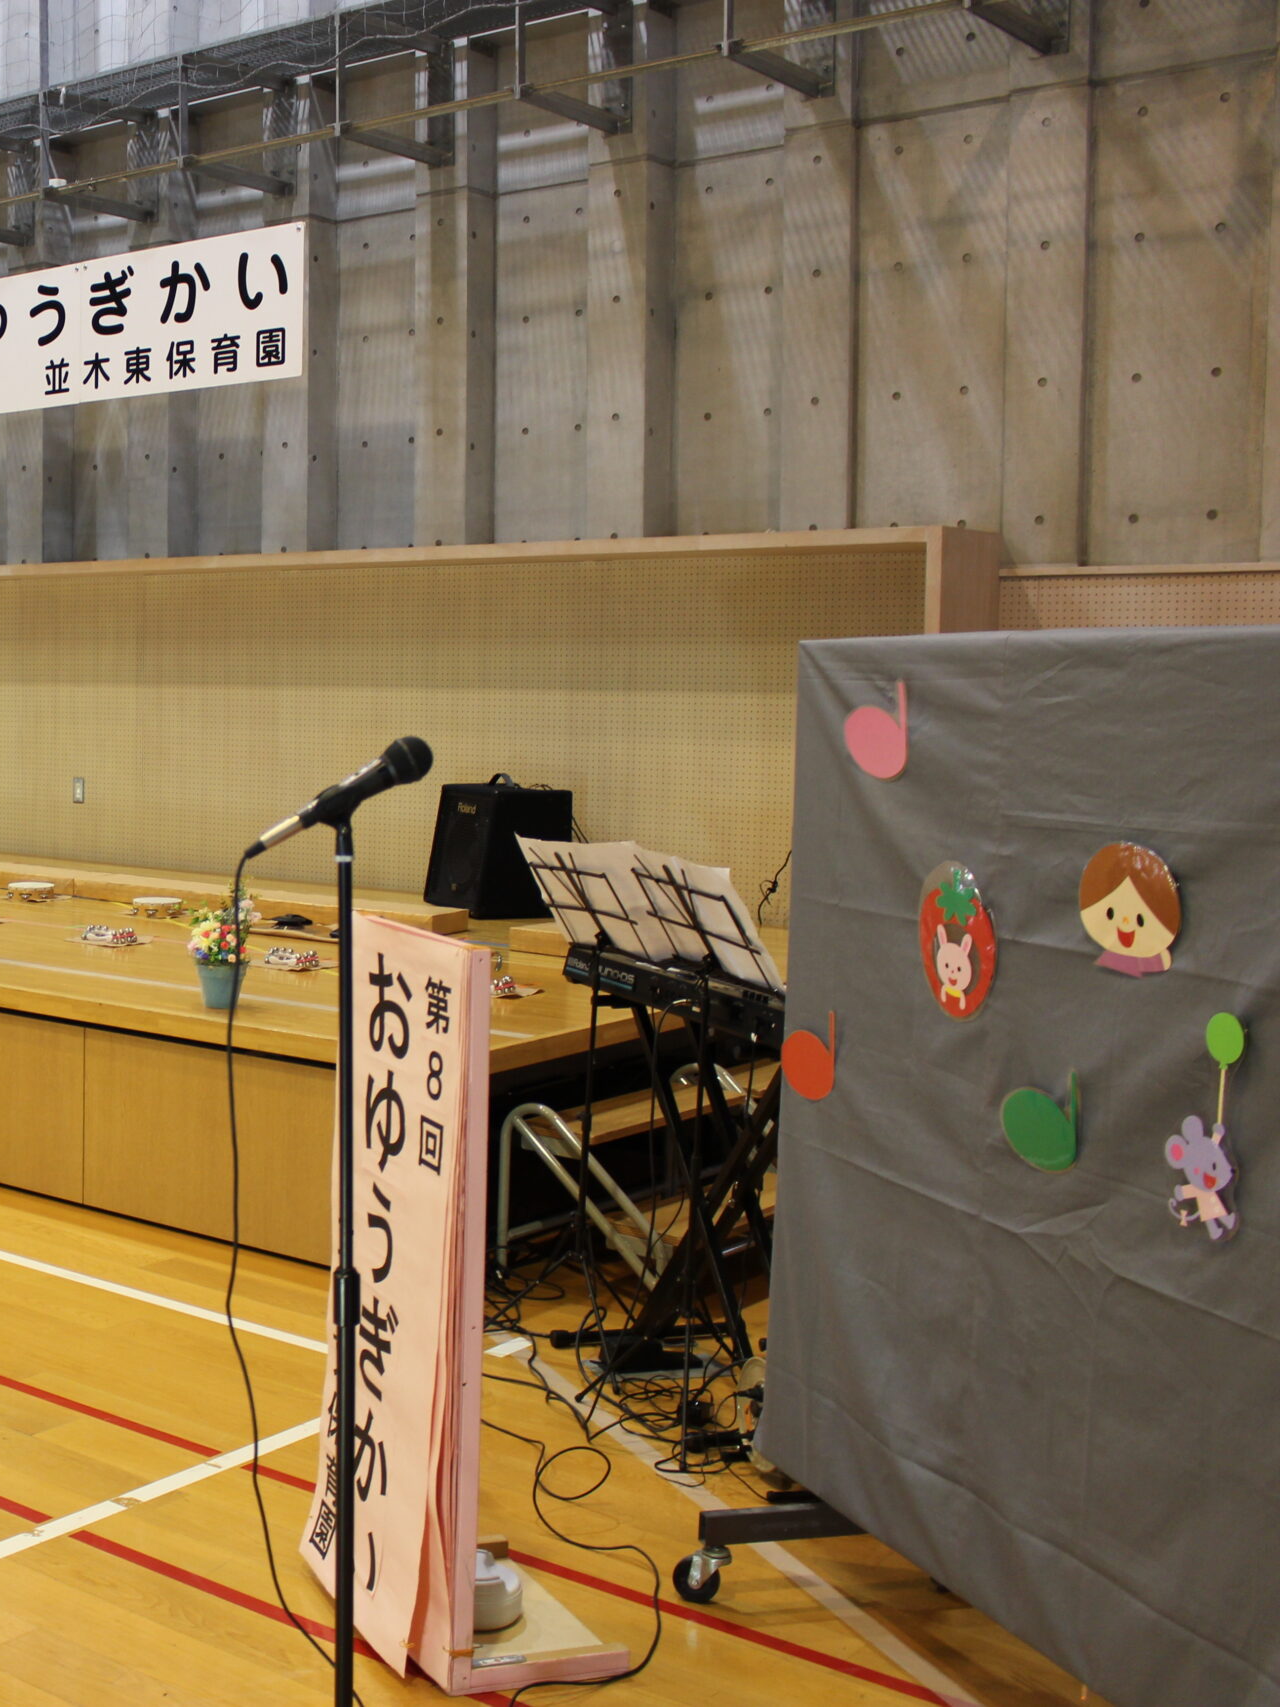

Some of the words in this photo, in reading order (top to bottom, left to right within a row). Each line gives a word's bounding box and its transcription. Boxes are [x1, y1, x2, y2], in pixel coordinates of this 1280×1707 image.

[44, 326, 286, 396] 並木東保育園
[417, 975, 453, 1177] 第8回
